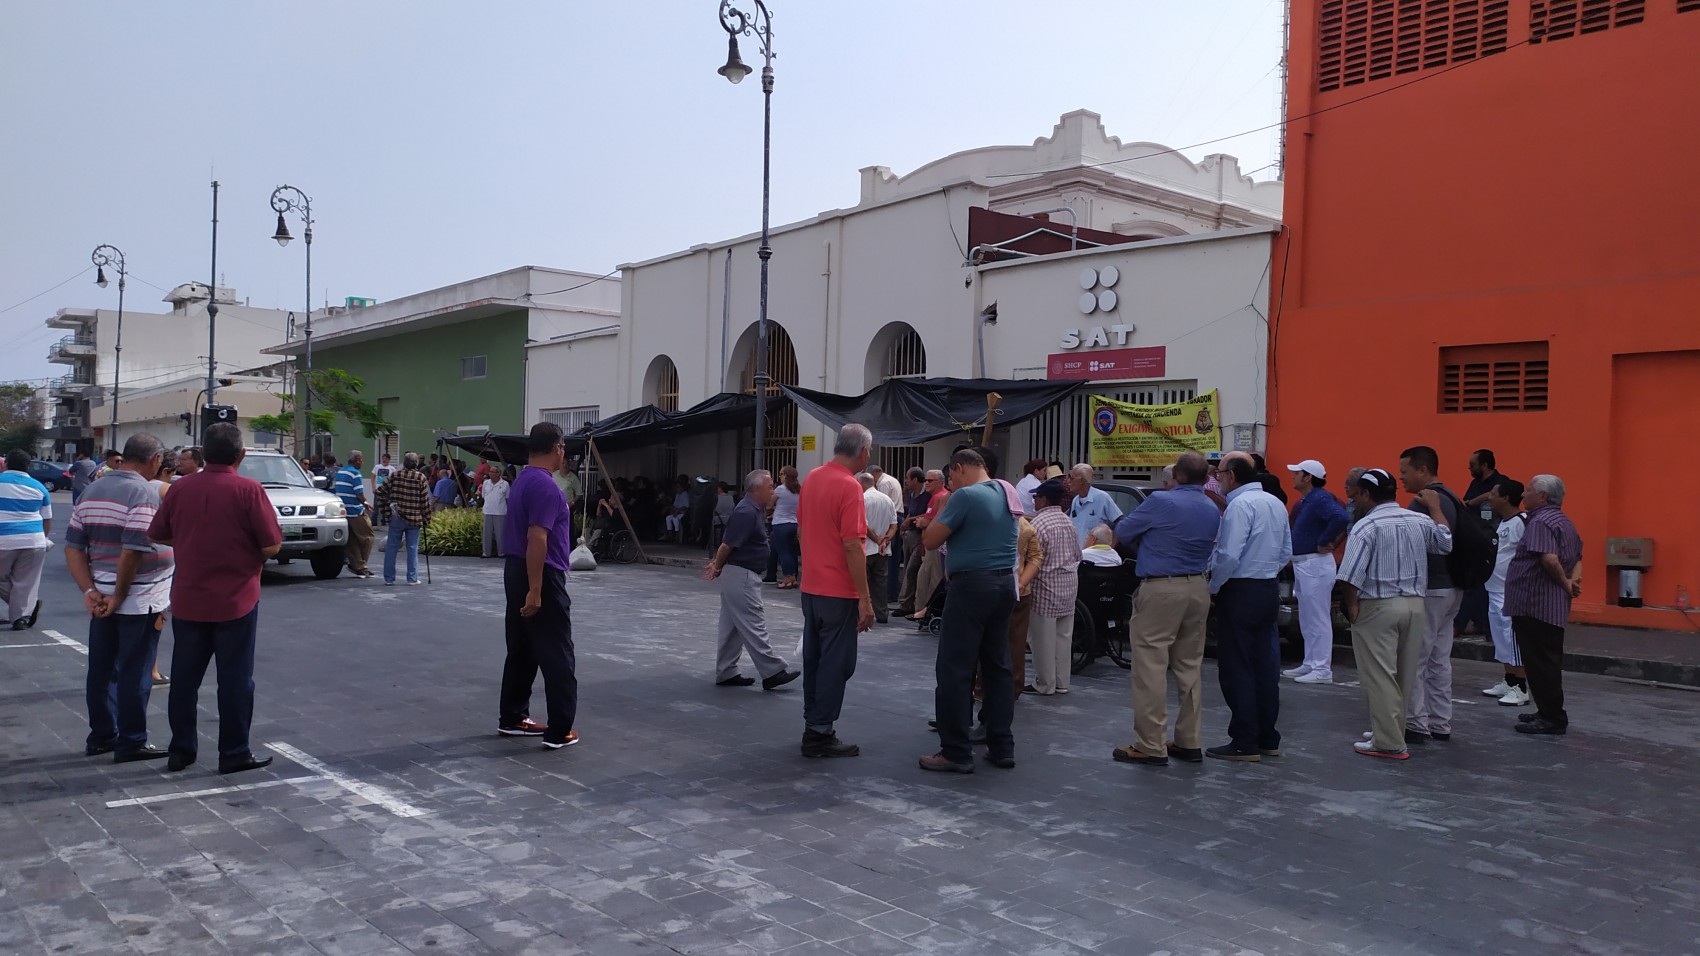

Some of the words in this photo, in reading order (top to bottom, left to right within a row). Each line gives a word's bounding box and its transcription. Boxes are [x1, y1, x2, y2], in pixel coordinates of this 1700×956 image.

[1060, 324, 1134, 349] SAT
[1064, 361, 1082, 369] SHCP
[1118, 424, 1154, 434] EXIGIMO
